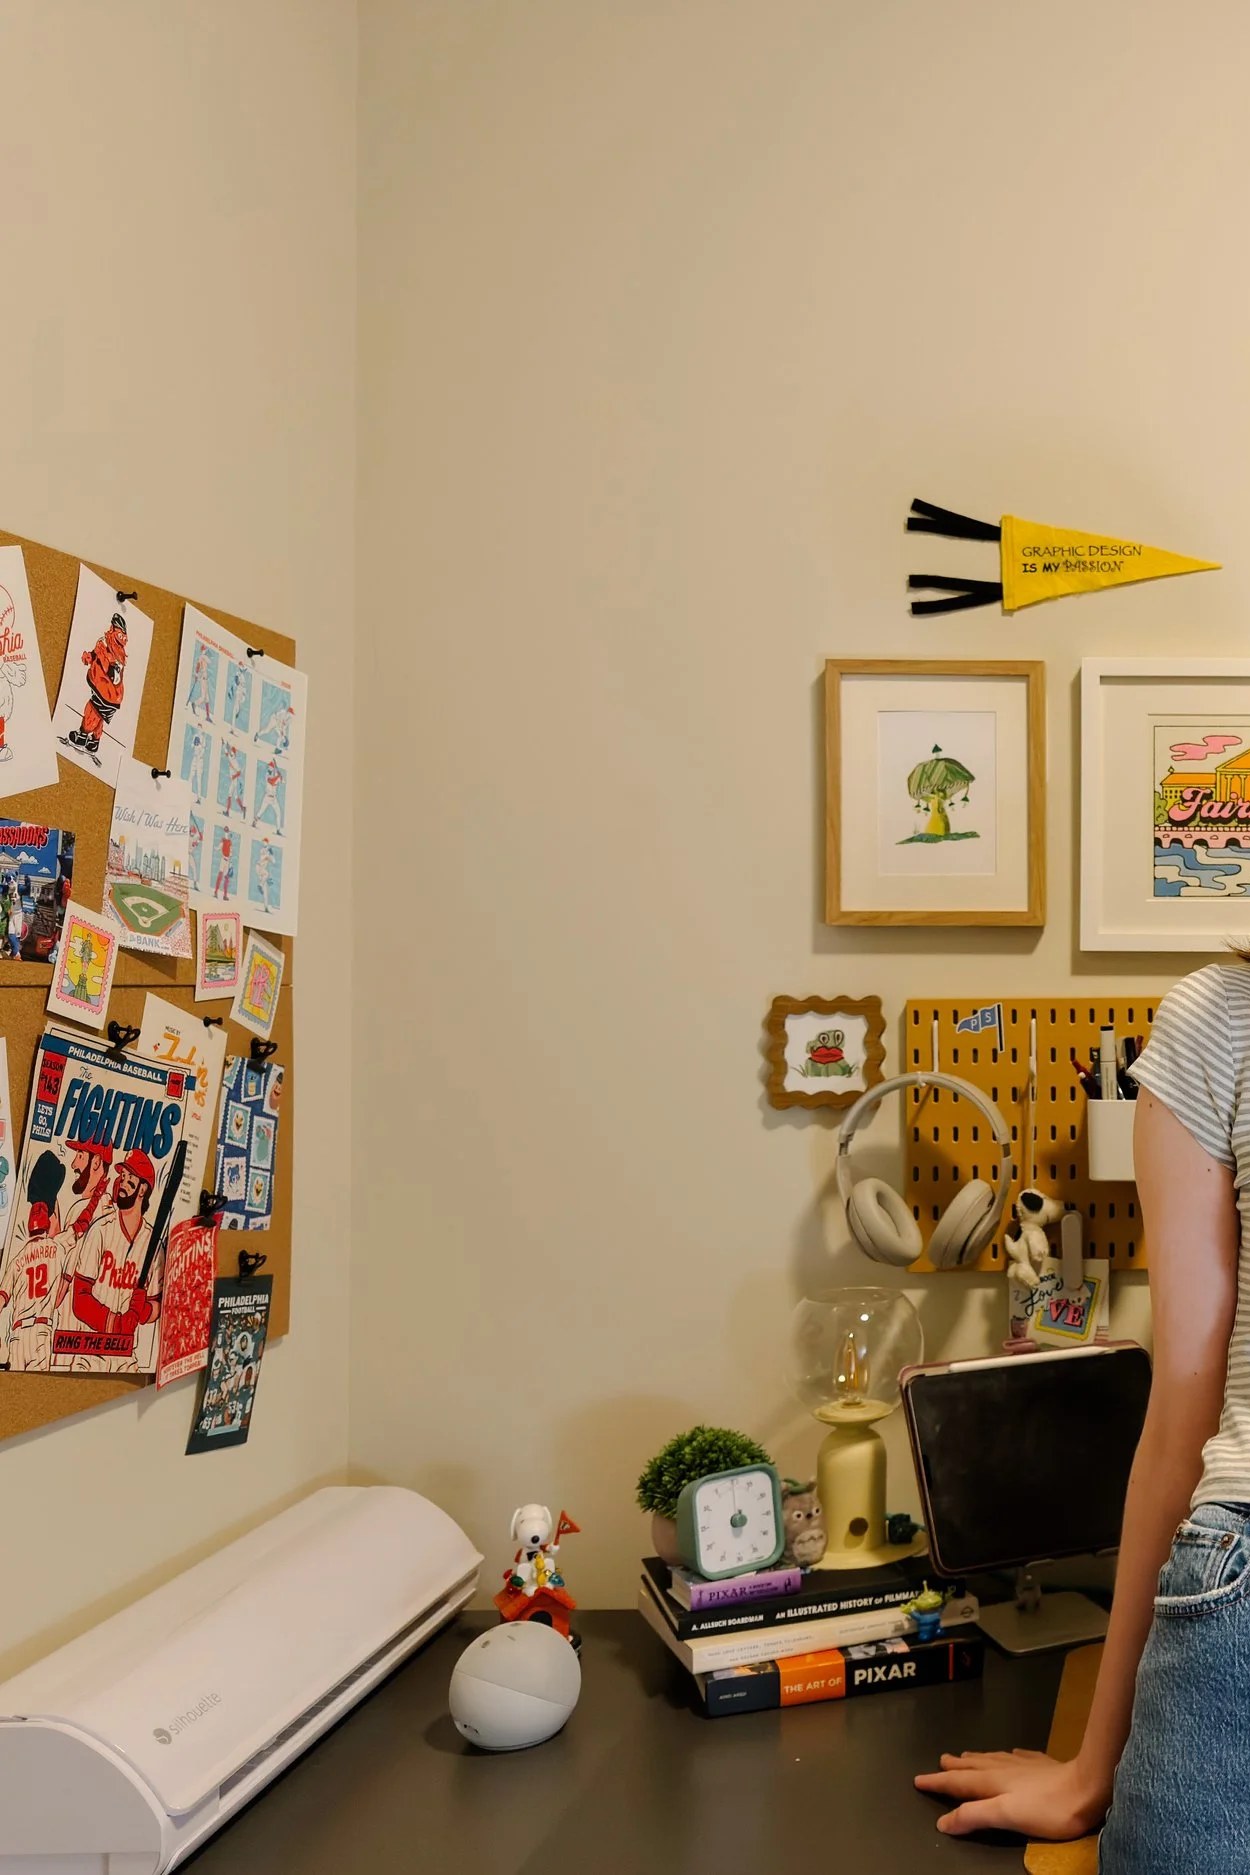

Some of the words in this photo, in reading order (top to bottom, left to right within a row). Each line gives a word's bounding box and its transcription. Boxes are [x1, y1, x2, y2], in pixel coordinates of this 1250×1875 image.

[1022, 545, 1085, 557] GRAPHIC
[1088, 544, 1143, 557] DESIGN
[1022, 563, 1037, 573] IS
[1042, 562, 1060, 573] MY
[1062, 559, 1125, 573] PASSION
[0, 627, 23, 656] hia
[114, 806, 136, 823] Wish
[144, 813, 163, 828] Was
[165, 817, 189, 833] Here
[68, 1046, 122, 1070] PHILADELPHIA
[122, 1063, 163, 1083] BASEBALL
[79, 1066, 93, 1080] The
[54, 1078, 181, 1159] FIGHTINS
[15, 1245, 57, 1273] SCHWARBER
[98, 1251, 146, 1290] Philli
[26, 1263, 48, 1299] 12
[218, 1294, 269, 1308] PHILADELPHIA
[231, 1305, 256, 1315] FOOTBALL
[56, 1335, 81, 1350] RING
[83, 1336, 102, 1350] THE
[104, 1337, 131, 1351] BELL!
[708, 1587, 747, 1601] PIXAR
[701, 1619, 728, 1631] ALLSUCH
[728, 1614, 764, 1626] BOARDMAN
[775, 1611, 786, 1619] AN
[787, 1602, 838, 1618] ILLUSTRATED
[840, 1597, 874, 1610] HISTORY
[784, 1683, 803, 1694] THE
[806, 1679, 825, 1690] ART
[828, 1676, 843, 1687] OF
[854, 1661, 917, 1686] PIXAR
[168, 1693, 222, 1735] silhouette
